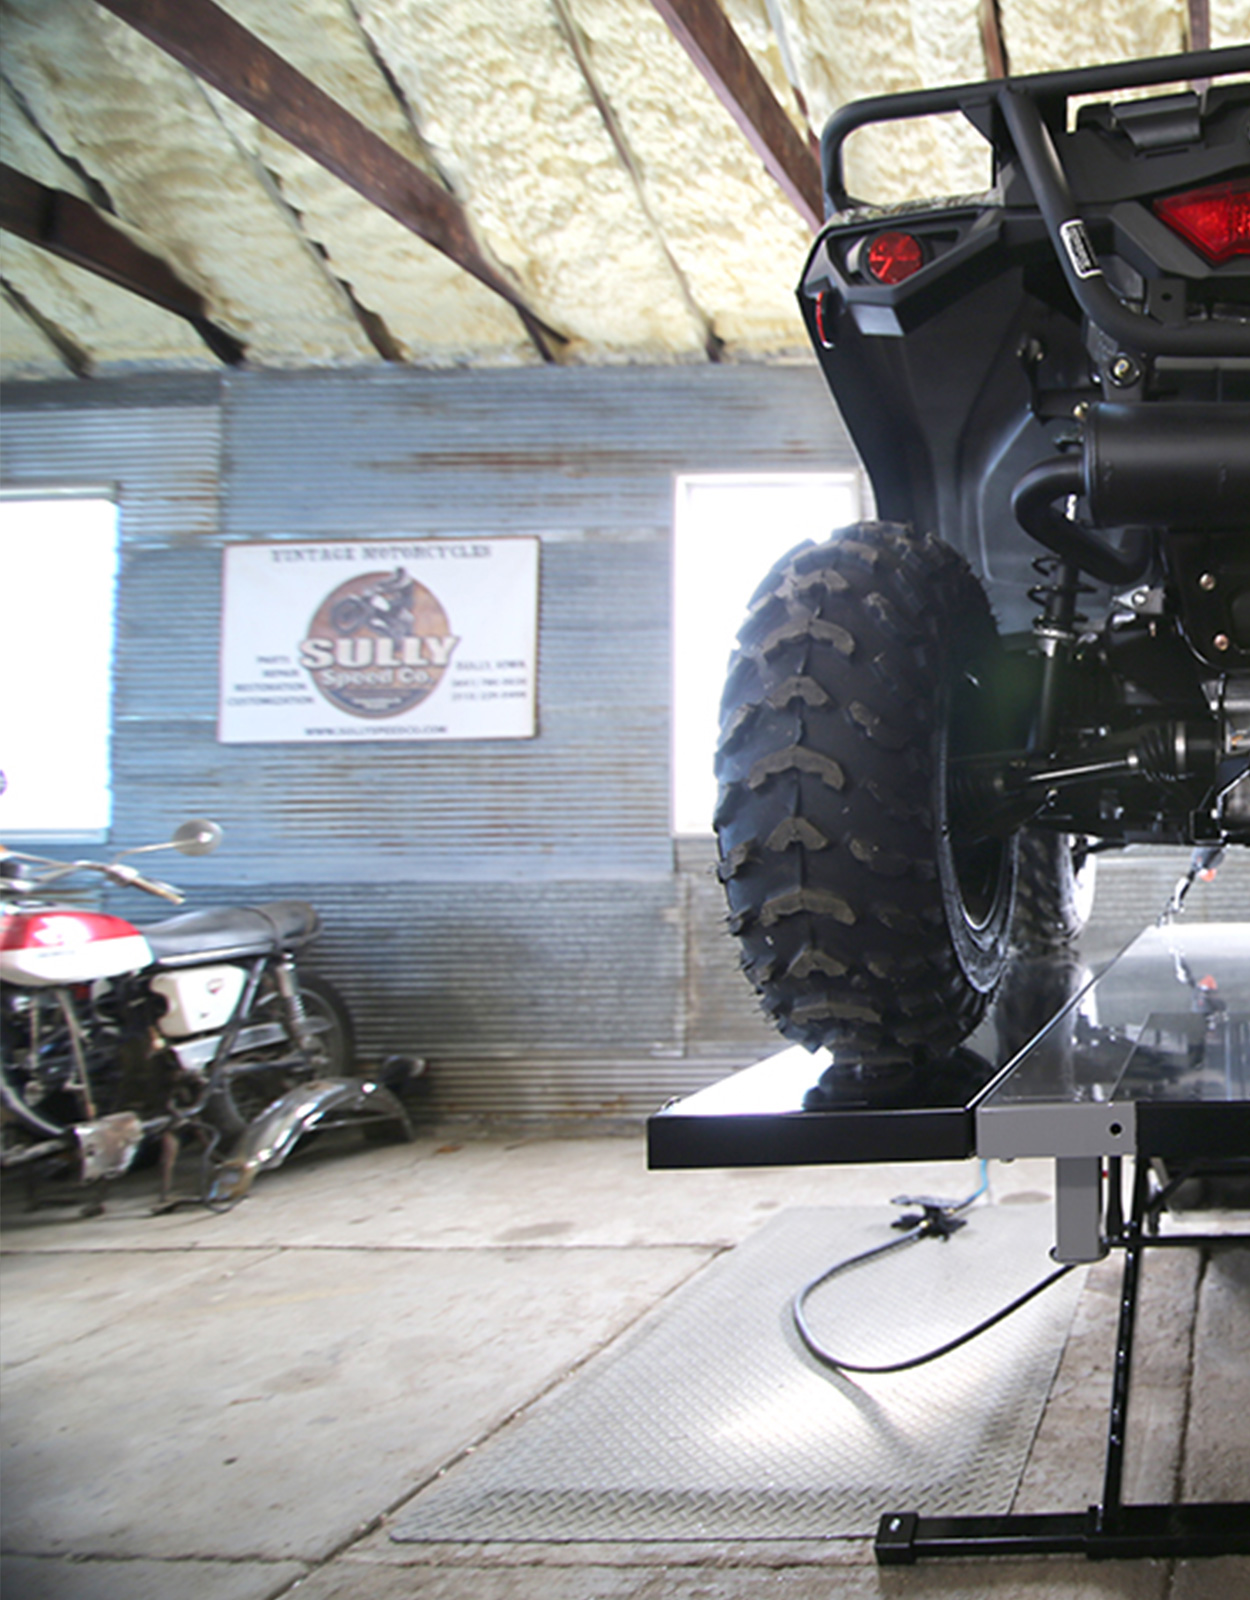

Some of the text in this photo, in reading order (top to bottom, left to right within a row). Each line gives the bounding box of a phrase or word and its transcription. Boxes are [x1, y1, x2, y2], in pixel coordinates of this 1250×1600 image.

[272, 545, 492, 563] VINTAGE MOTORCYCLES
[299, 635, 462, 669] SULLY
[320, 668, 394, 687] Speed
